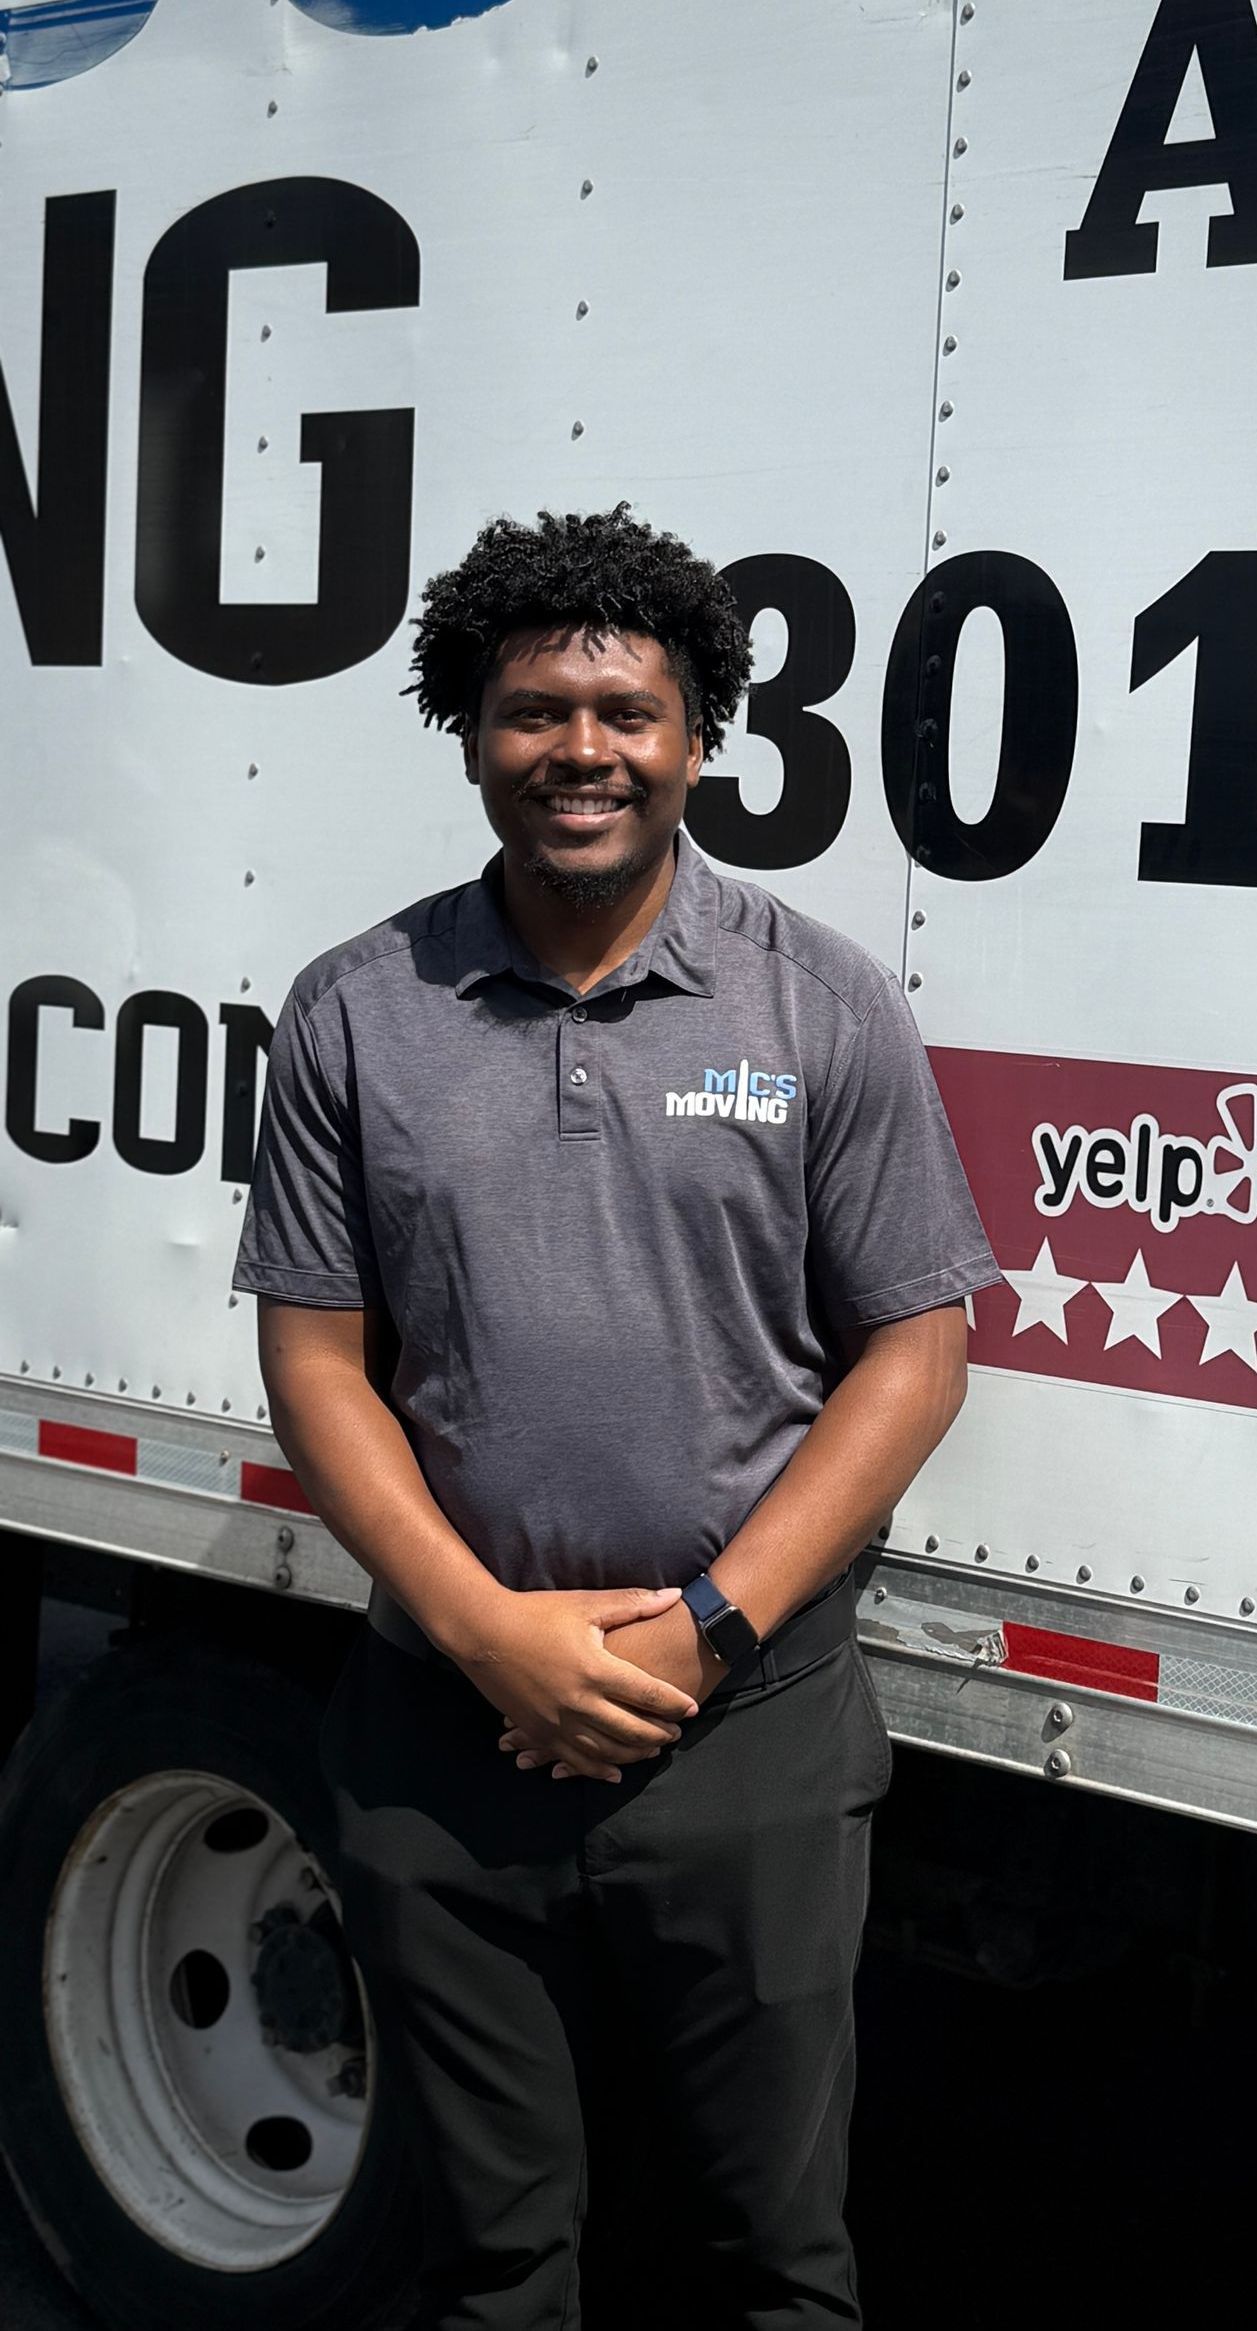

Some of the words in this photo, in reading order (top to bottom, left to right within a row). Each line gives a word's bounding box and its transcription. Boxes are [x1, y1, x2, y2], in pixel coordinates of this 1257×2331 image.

[665, 1088, 788, 1124] MOVING
[704, 1059, 797, 1106] MIC'S
[1038, 1122, 1204, 1224] yelp
